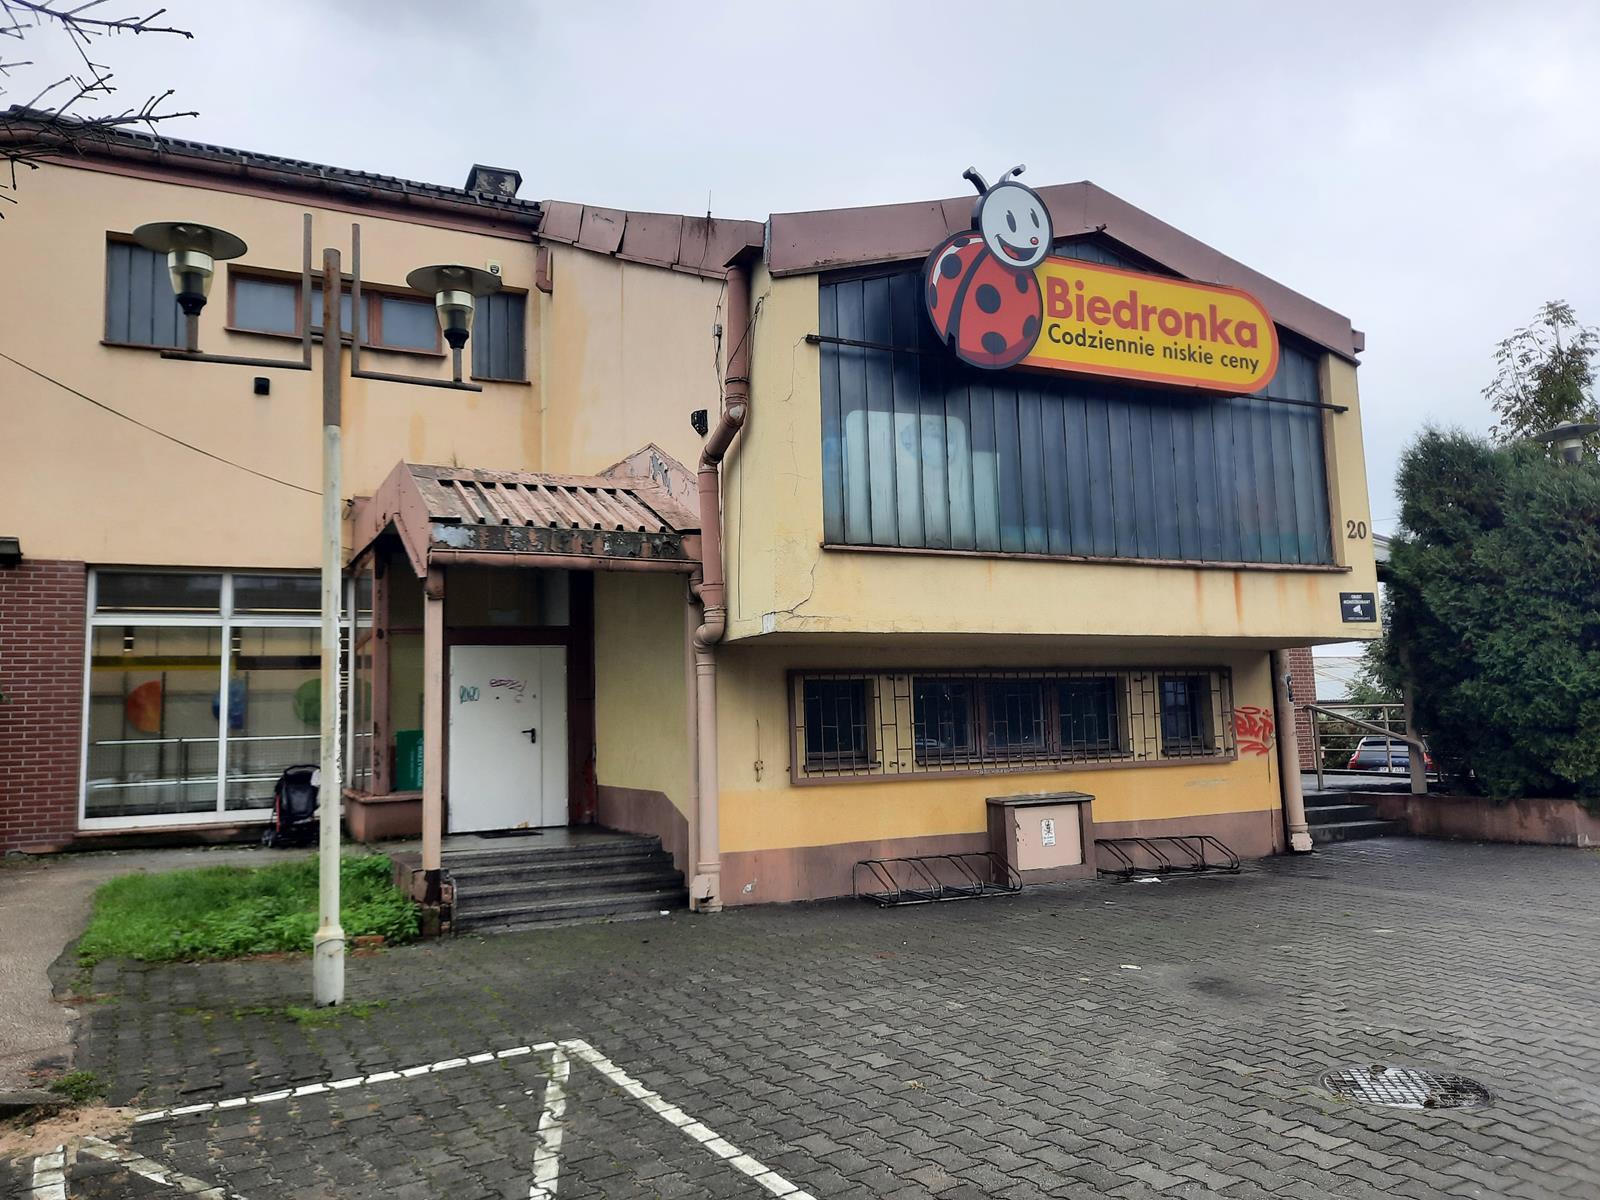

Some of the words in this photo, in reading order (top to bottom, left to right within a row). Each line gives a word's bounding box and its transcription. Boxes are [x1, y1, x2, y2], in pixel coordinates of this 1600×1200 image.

[1046, 276, 1258, 349] Biedronka
[1048, 323, 1155, 356] Codziennie
[1162, 341, 1214, 365] niskie
[1221, 353, 1260, 375] ceny
[1346, 519, 1367, 540] 20
